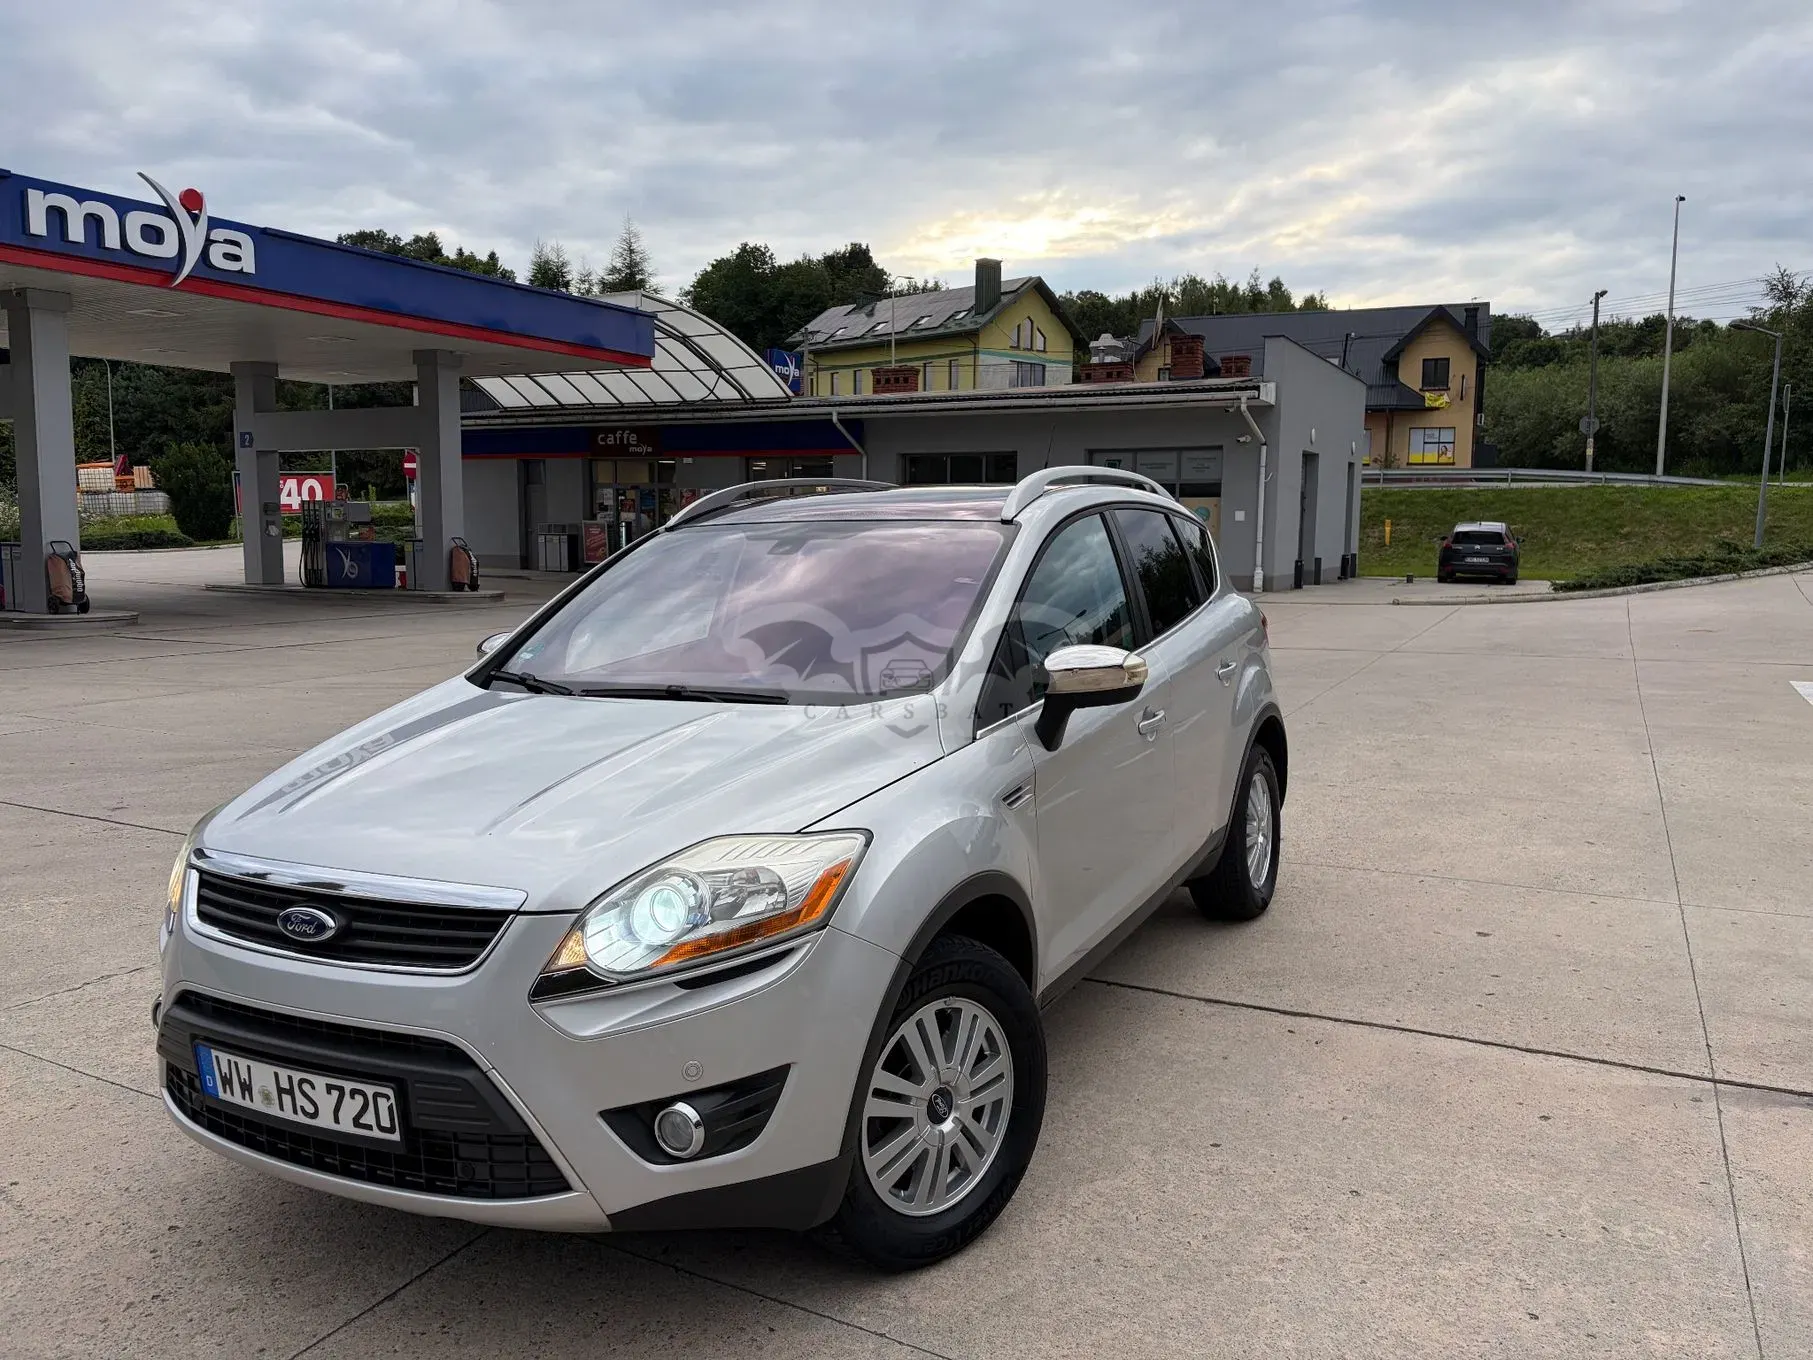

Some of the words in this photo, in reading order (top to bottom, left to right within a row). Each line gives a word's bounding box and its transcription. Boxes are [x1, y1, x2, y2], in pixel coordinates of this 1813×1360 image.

[26, 171, 256, 287] moya
[775, 353, 800, 386] moya
[244, 434, 250, 446] 2
[597, 430, 637, 444] caffe
[629, 442, 653, 456] moya
[280, 478, 323, 509] 40
[287, 913, 318, 934] Ford
[206, 1075, 213, 1087] D
[214, 1054, 254, 1104] WW
[273, 1071, 320, 1121] HS
[326, 1083, 398, 1135] 720
